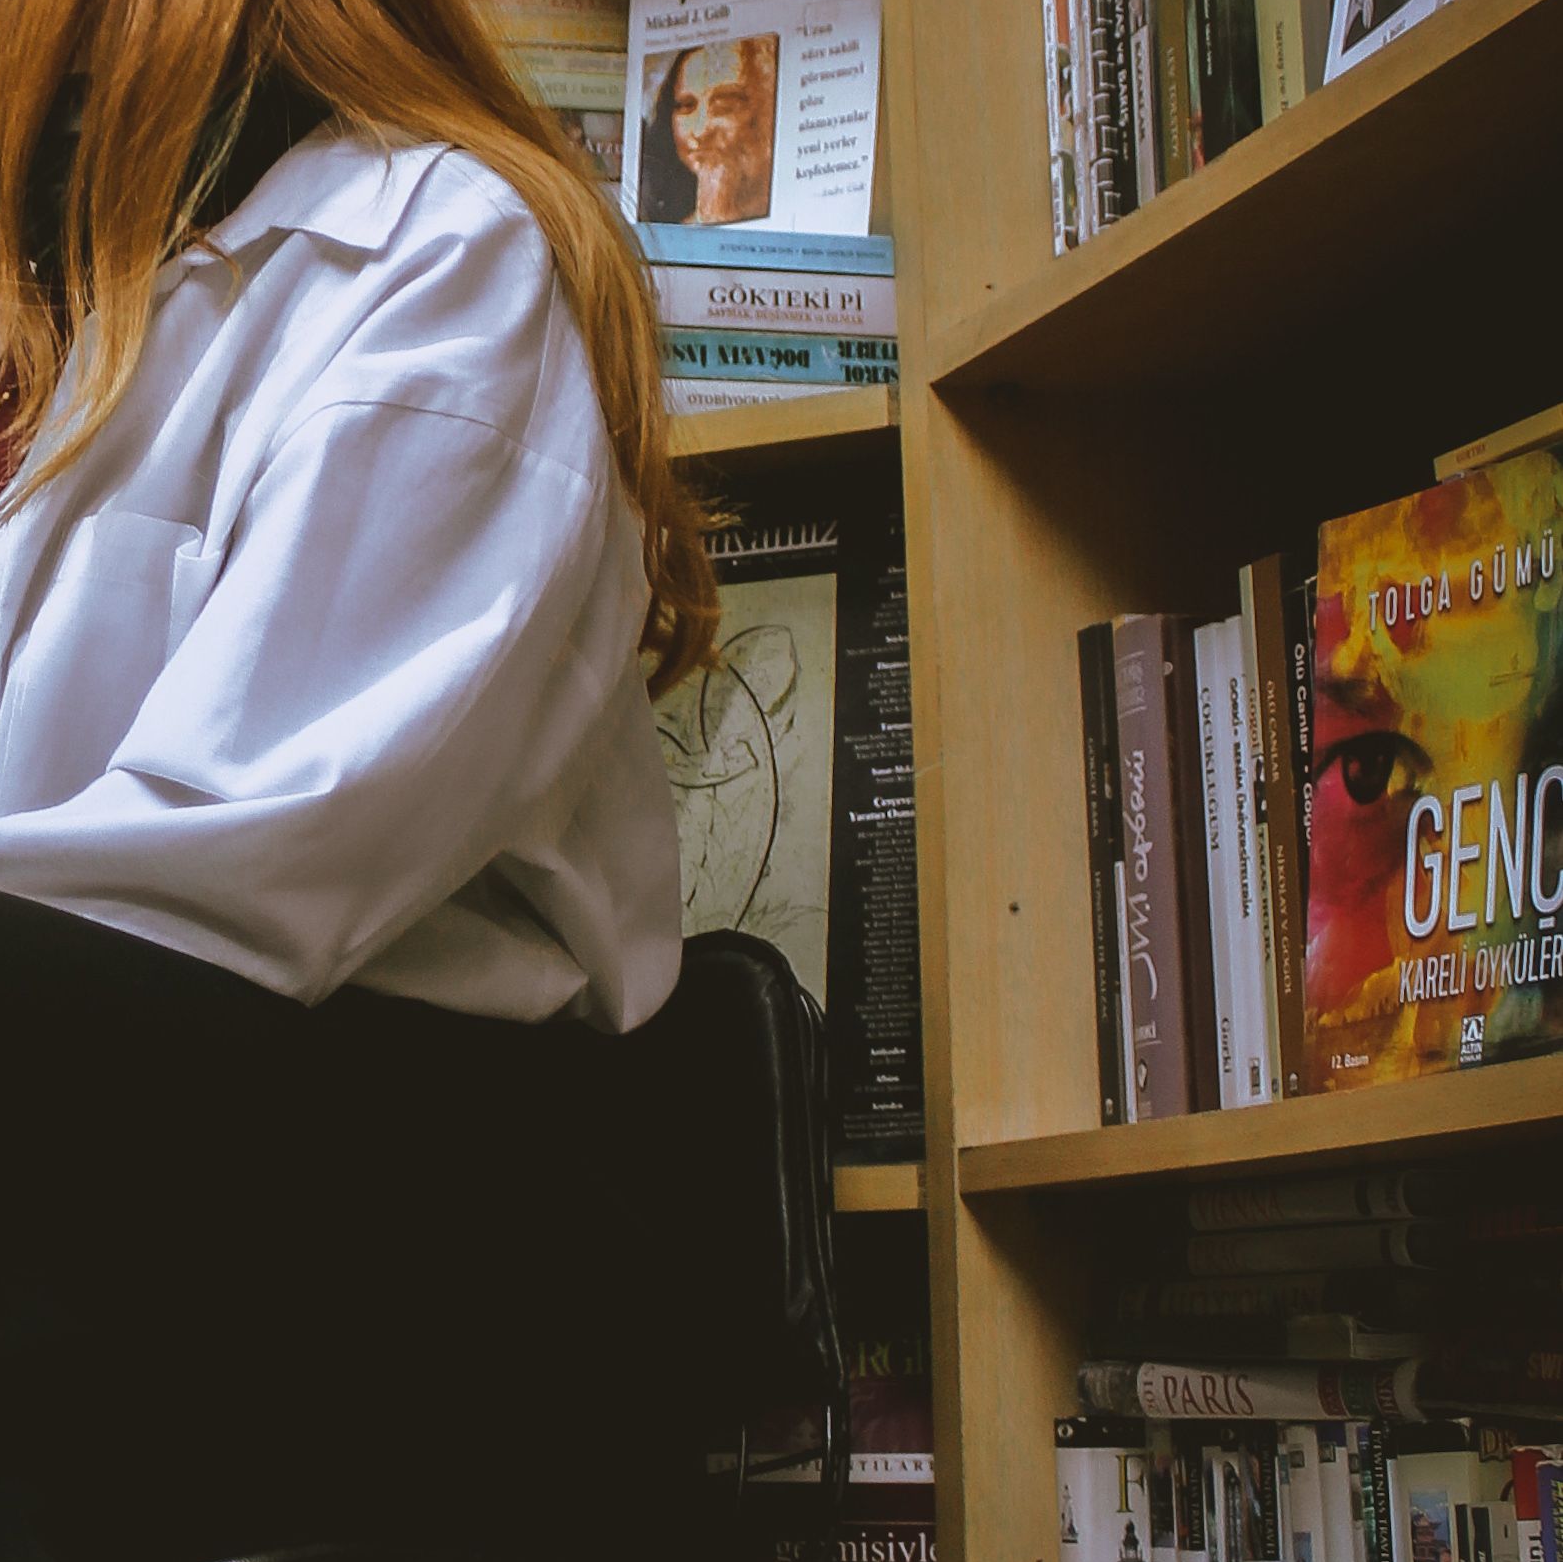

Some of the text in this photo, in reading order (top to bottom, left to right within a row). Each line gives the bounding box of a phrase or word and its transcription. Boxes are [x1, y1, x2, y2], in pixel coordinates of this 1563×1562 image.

[644, 11, 689, 31] Michael
[708, 283, 863, 311] GÖKTEKİ Pİ
[1367, 529, 1557, 631] TOLGA GÜMÜ
[1294, 682, 1309, 755] Canlar
[1403, 761, 1563, 940] GENÇ
[1396, 945, 1471, 1004] KARELİ
[1459, 1041, 1485, 1056] ALTIN
